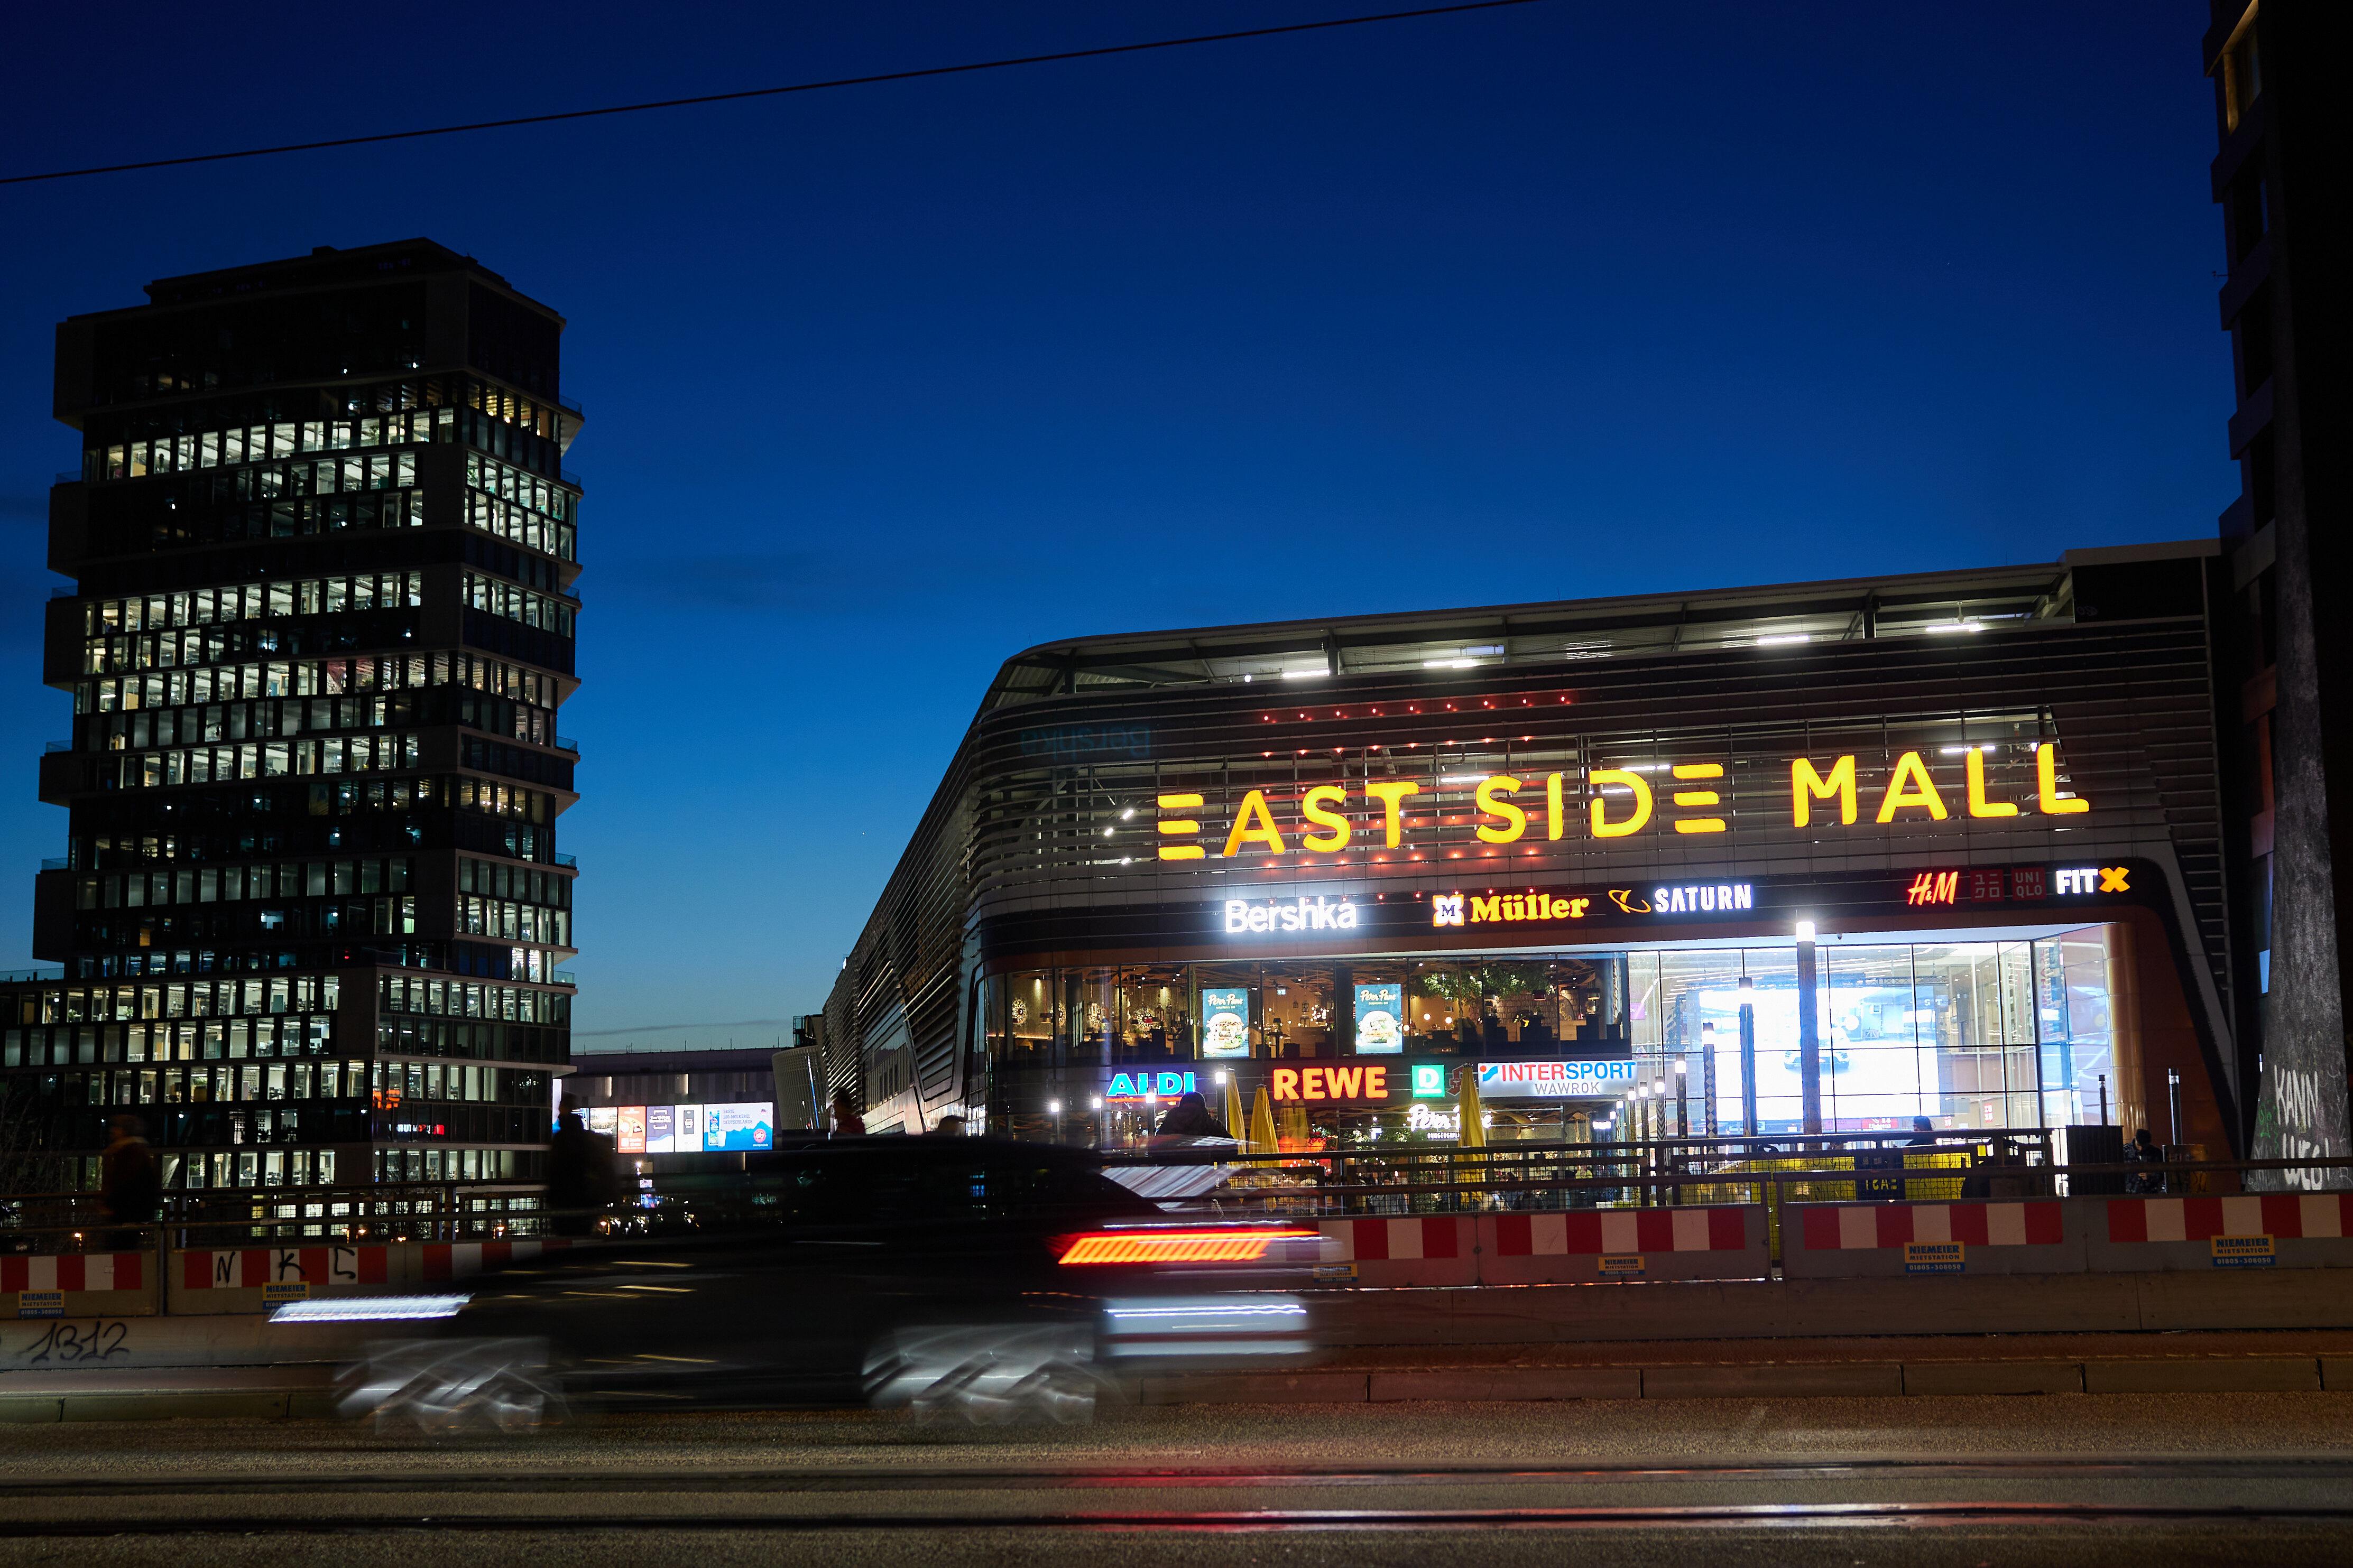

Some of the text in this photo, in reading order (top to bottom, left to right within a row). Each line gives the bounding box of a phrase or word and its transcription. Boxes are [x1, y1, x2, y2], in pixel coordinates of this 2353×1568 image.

[1158, 744, 2090, 860] EAST SIDE MALL
[1908, 871, 1958, 905] H&M
[2015, 870, 2040, 883] UNI
[1655, 885, 1751, 913] SATURN
[2016, 885, 2042, 897] QLO
[1225, 896, 1357, 933] Bershka
[1470, 894, 1589, 922] Müller
[1106, 1072, 1196, 1097] ALDI
[1274, 1066, 1388, 1099] REWE
[1418, 1068, 1439, 1088] D
[1502, 1062, 1635, 1081] INTERSPORT
[1535, 1082, 1600, 1095] WAWROK
[2274, 1064, 2319, 1128] KANN
[1909, 1245, 1959, 1254] NIEMEIER
[2216, 1238, 2268, 1247] NIEMEIER
[24, 1321, 130, 1364] 1312
